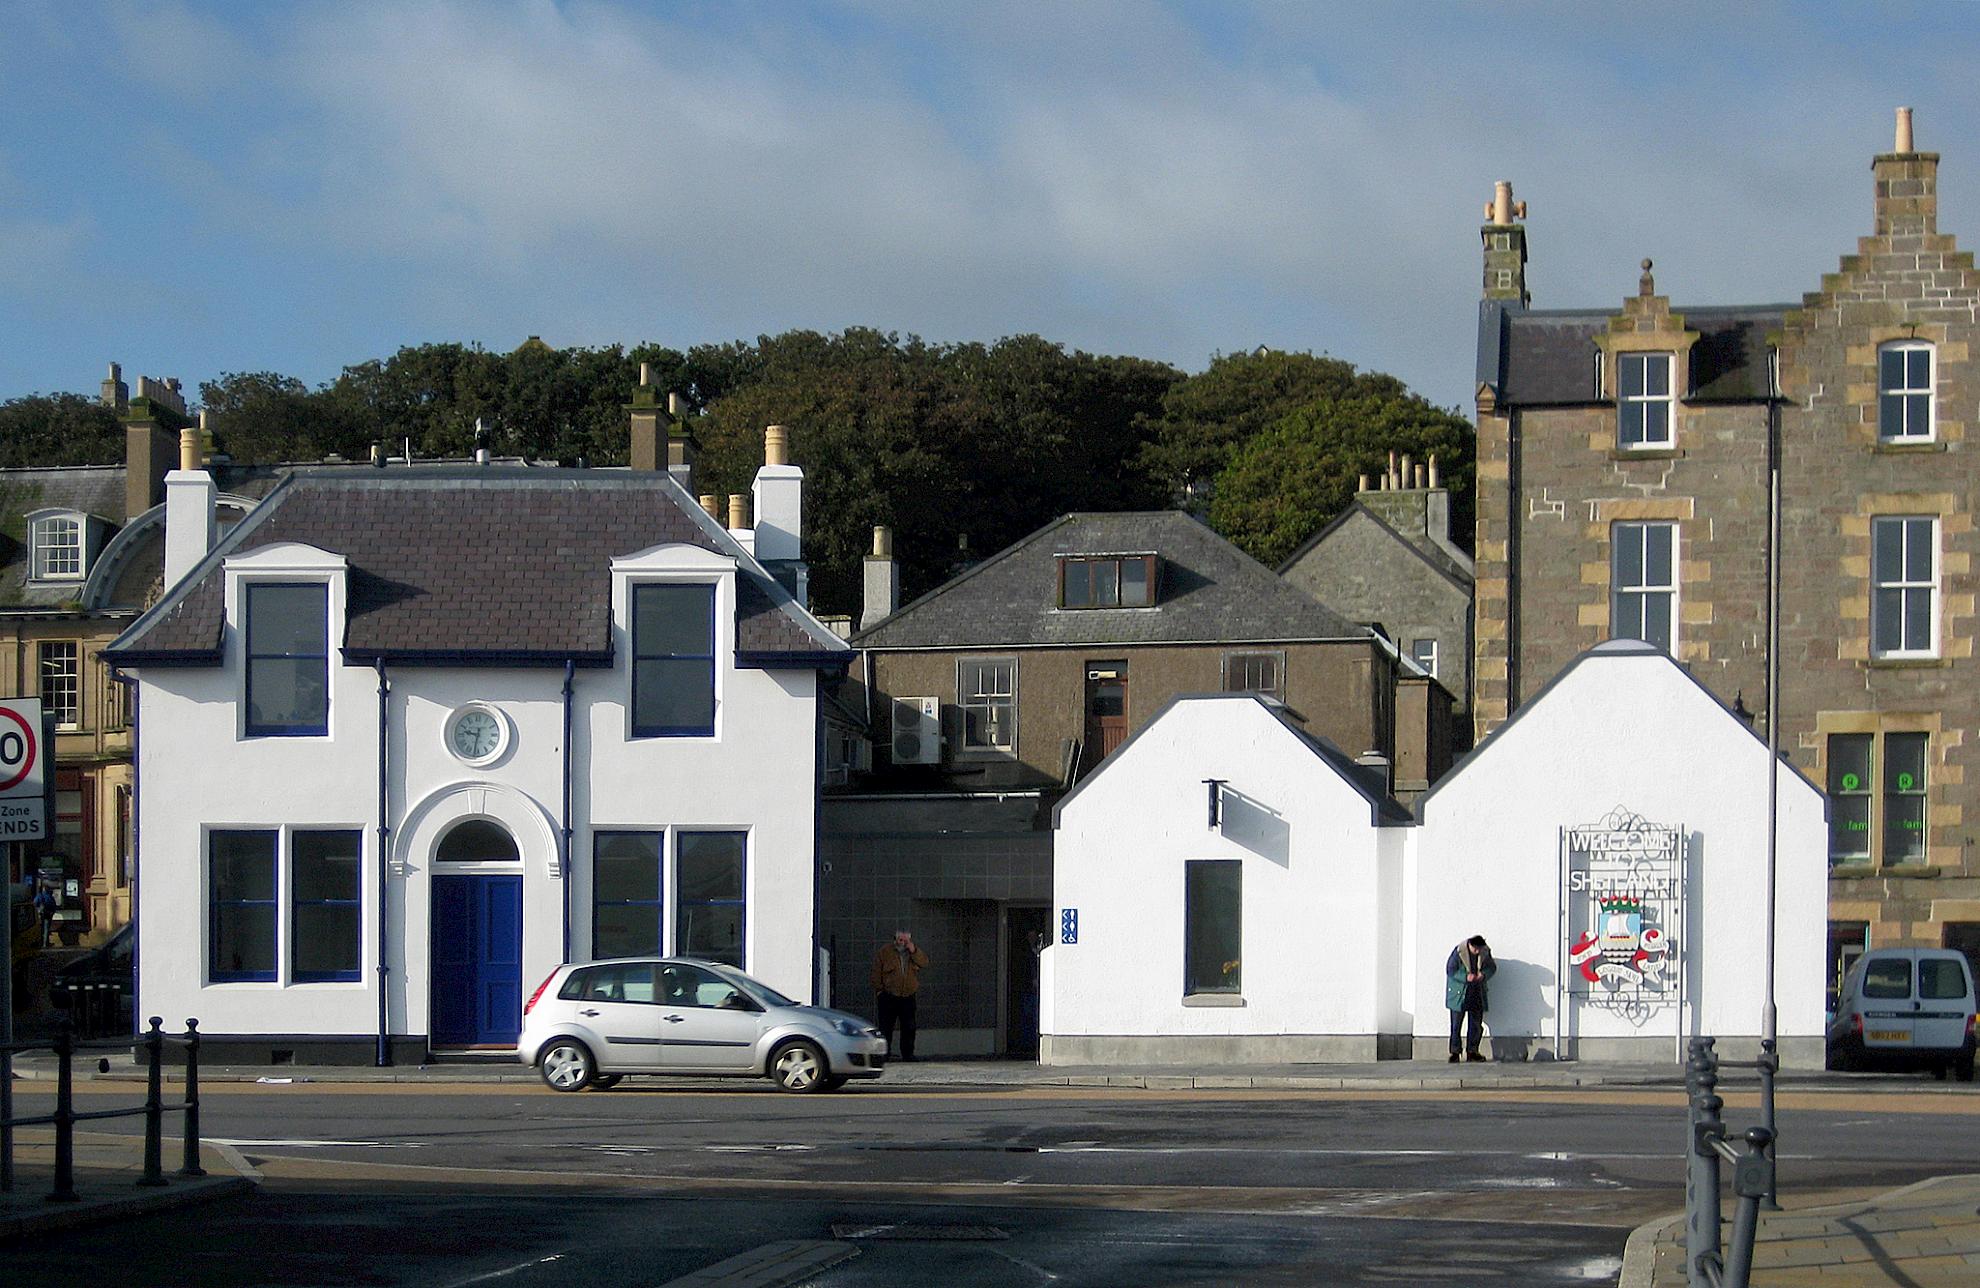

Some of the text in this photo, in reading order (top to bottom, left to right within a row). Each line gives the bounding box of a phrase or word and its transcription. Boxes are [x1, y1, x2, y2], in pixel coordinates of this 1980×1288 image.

[1, 806, 30, 816] Zone
[1571, 831, 1670, 851] WELCOME
[1571, 871, 1670, 890] SHETLAND
